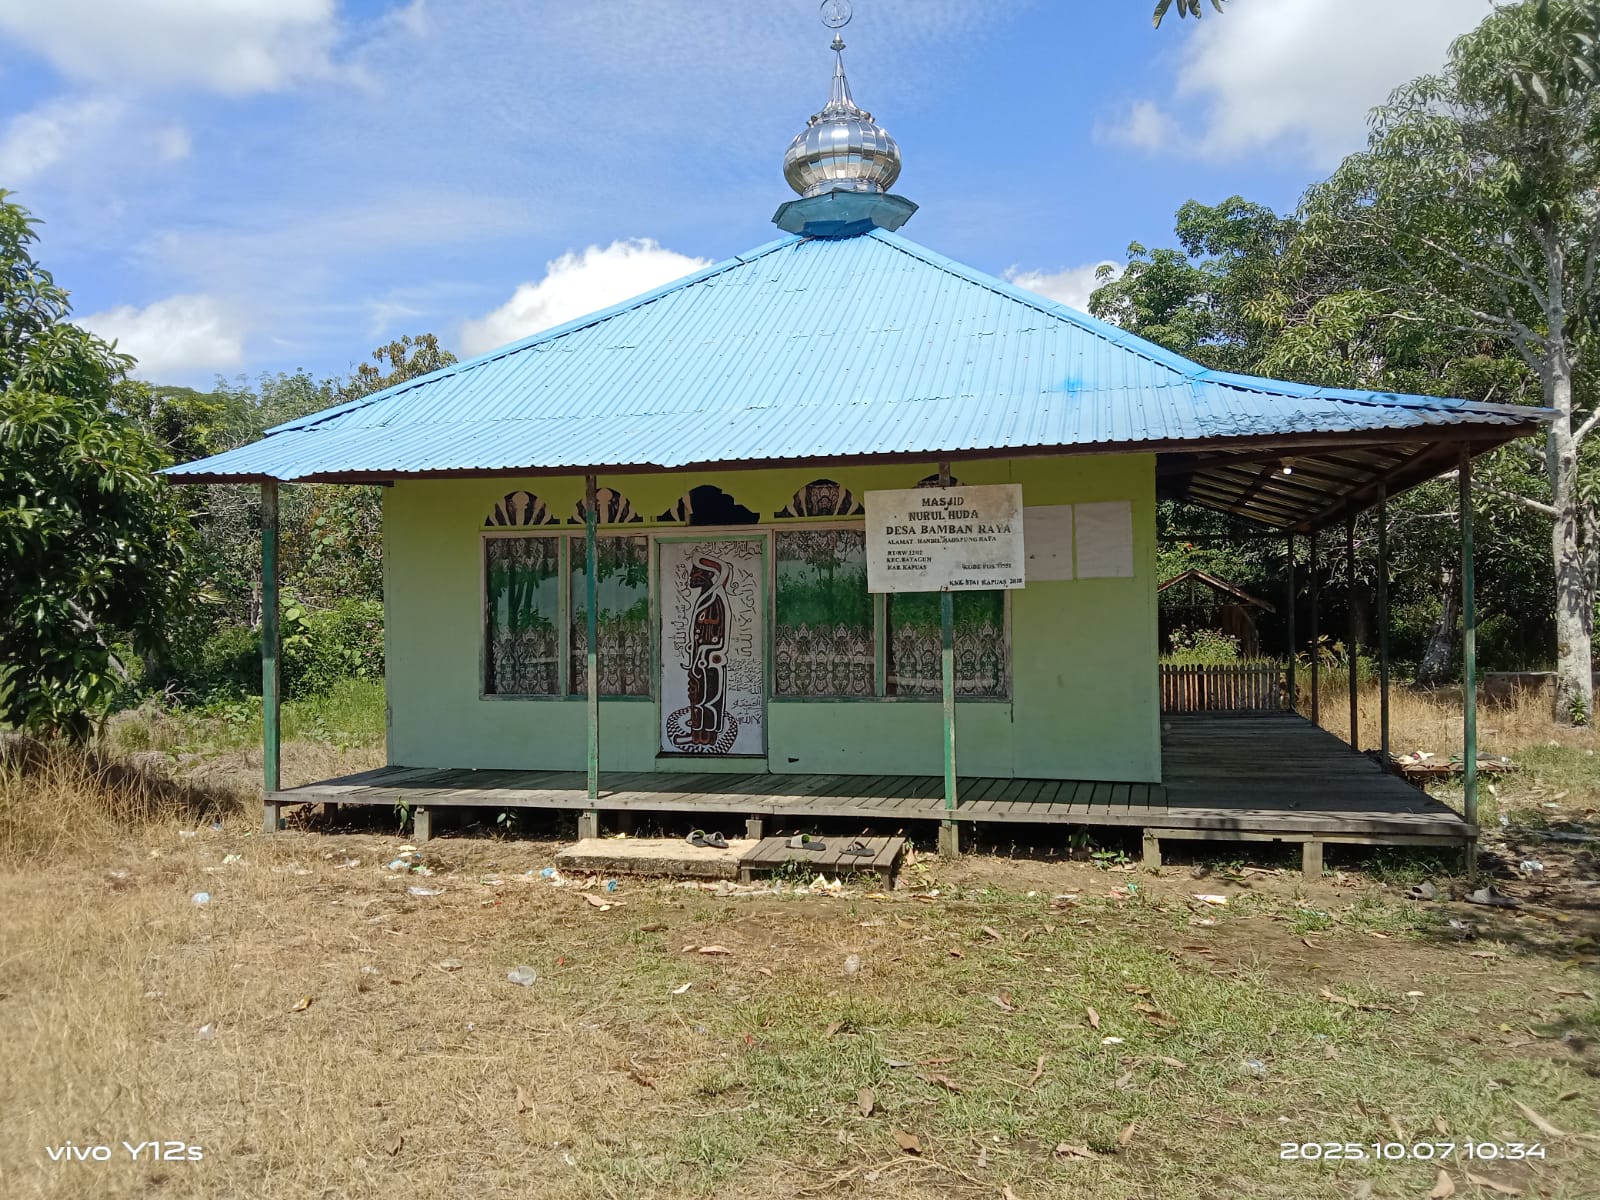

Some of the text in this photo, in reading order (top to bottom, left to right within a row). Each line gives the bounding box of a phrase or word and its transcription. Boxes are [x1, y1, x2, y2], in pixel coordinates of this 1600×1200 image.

[922, 497, 964, 507] MASJID
[909, 509, 979, 521] NURUL HUDA
[886, 523, 1011, 535] DESA BAMBAN RAYA
